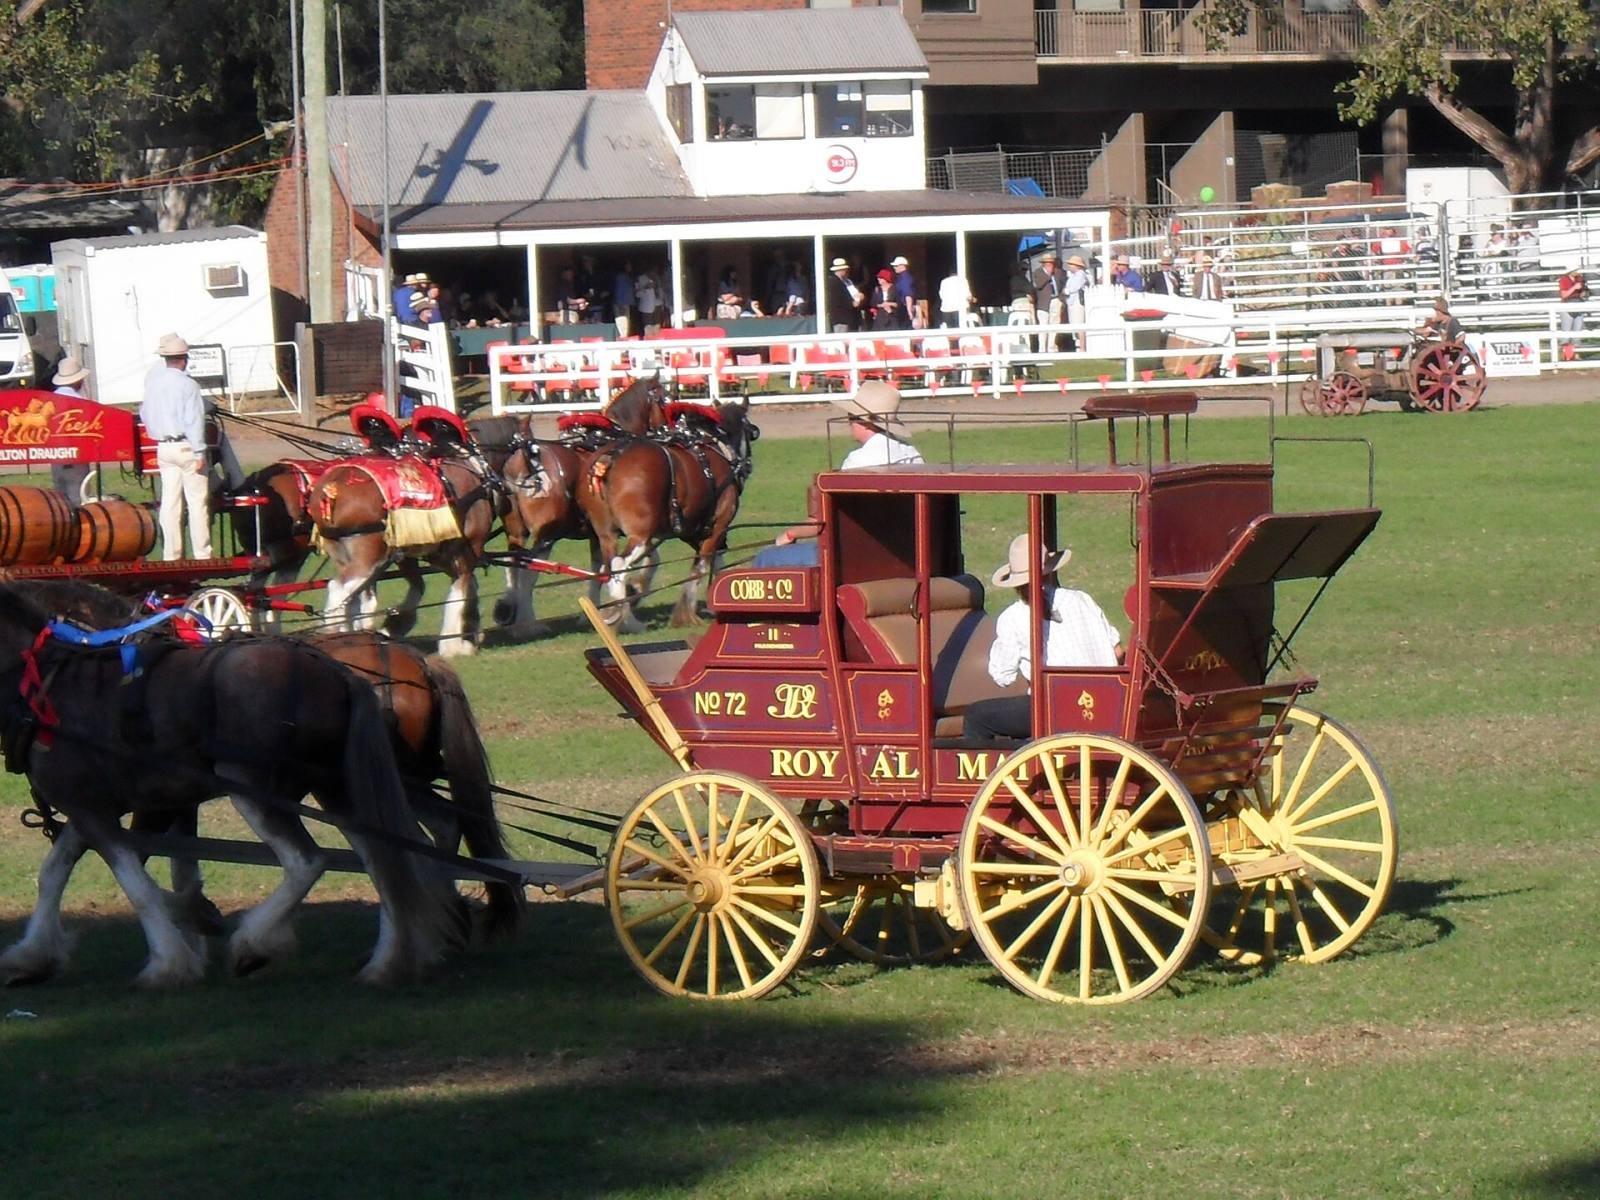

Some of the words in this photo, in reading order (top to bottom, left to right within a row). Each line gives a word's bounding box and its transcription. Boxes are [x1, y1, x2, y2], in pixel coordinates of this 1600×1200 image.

[51, 408, 104, 434] Fresh
[29, 447, 79, 460] DRAUGHT
[731, 579, 765, 599] COBB
[724, 691, 747, 716] 72
